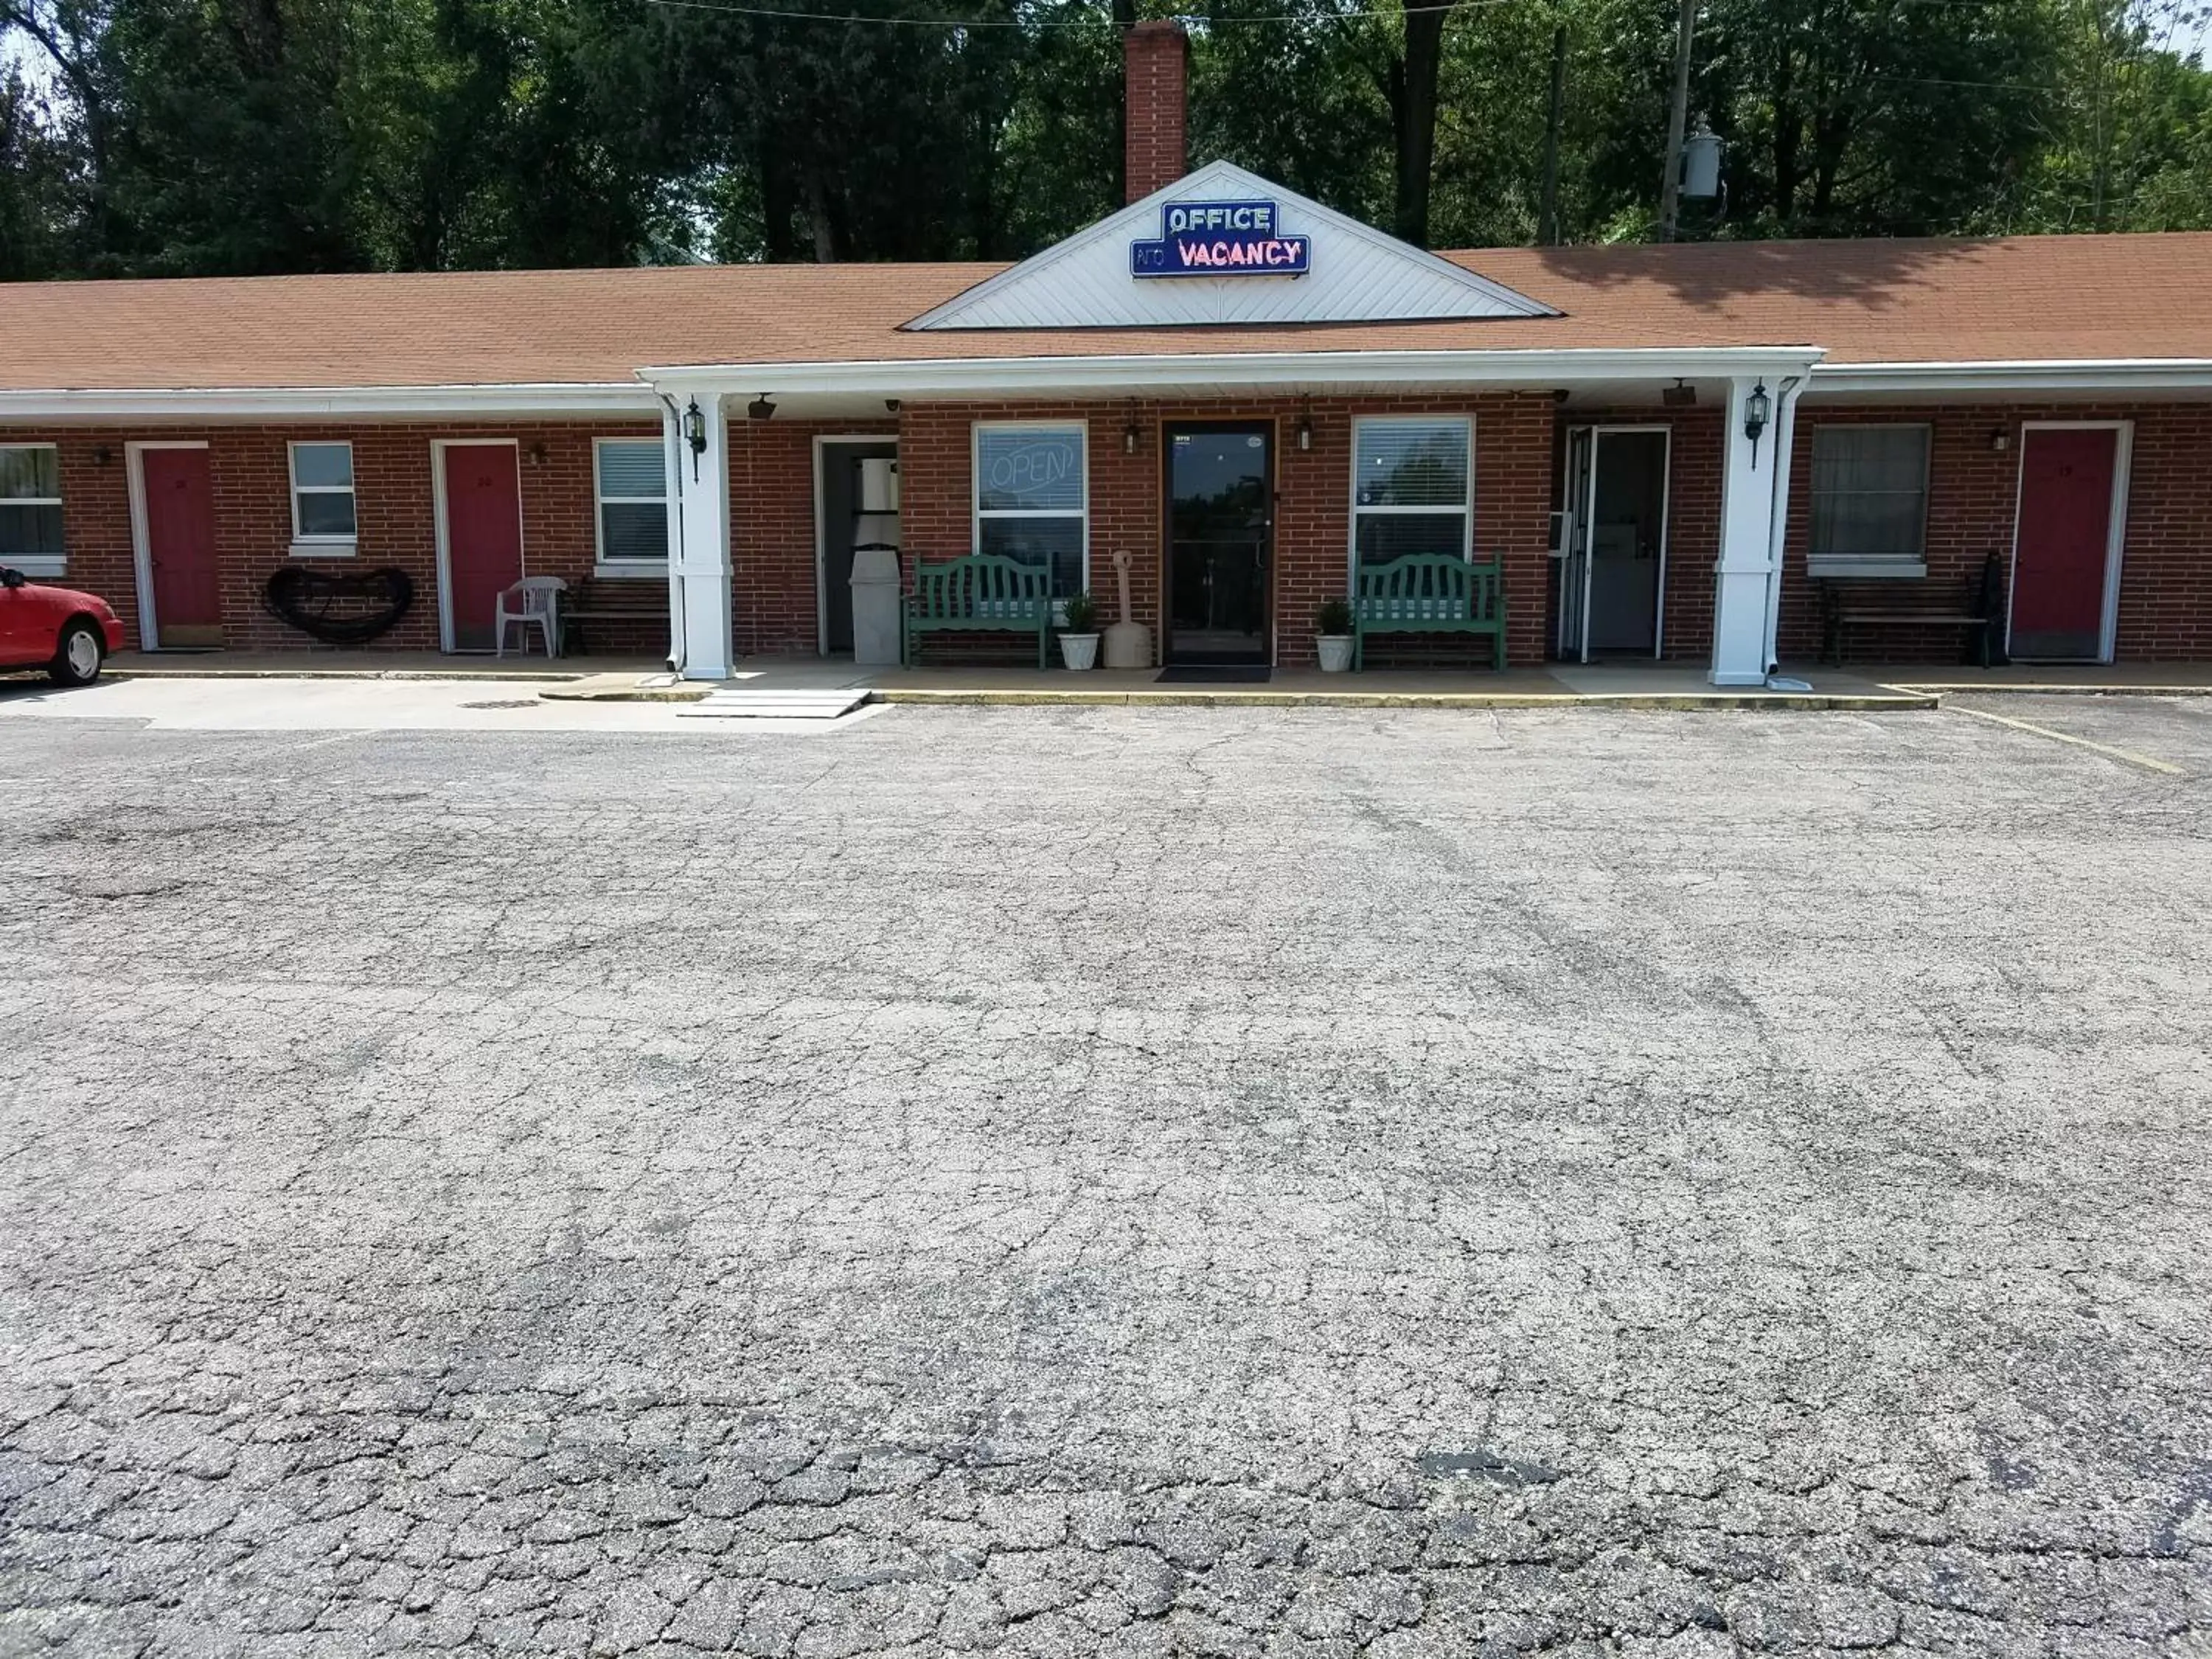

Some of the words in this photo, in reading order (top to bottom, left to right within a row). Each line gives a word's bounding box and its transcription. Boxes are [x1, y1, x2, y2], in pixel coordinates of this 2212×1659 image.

[1169, 208, 1270, 232] OFFICE
[1178, 240, 1301, 266] VACANCY
[992, 450, 1066, 486] OPEN
